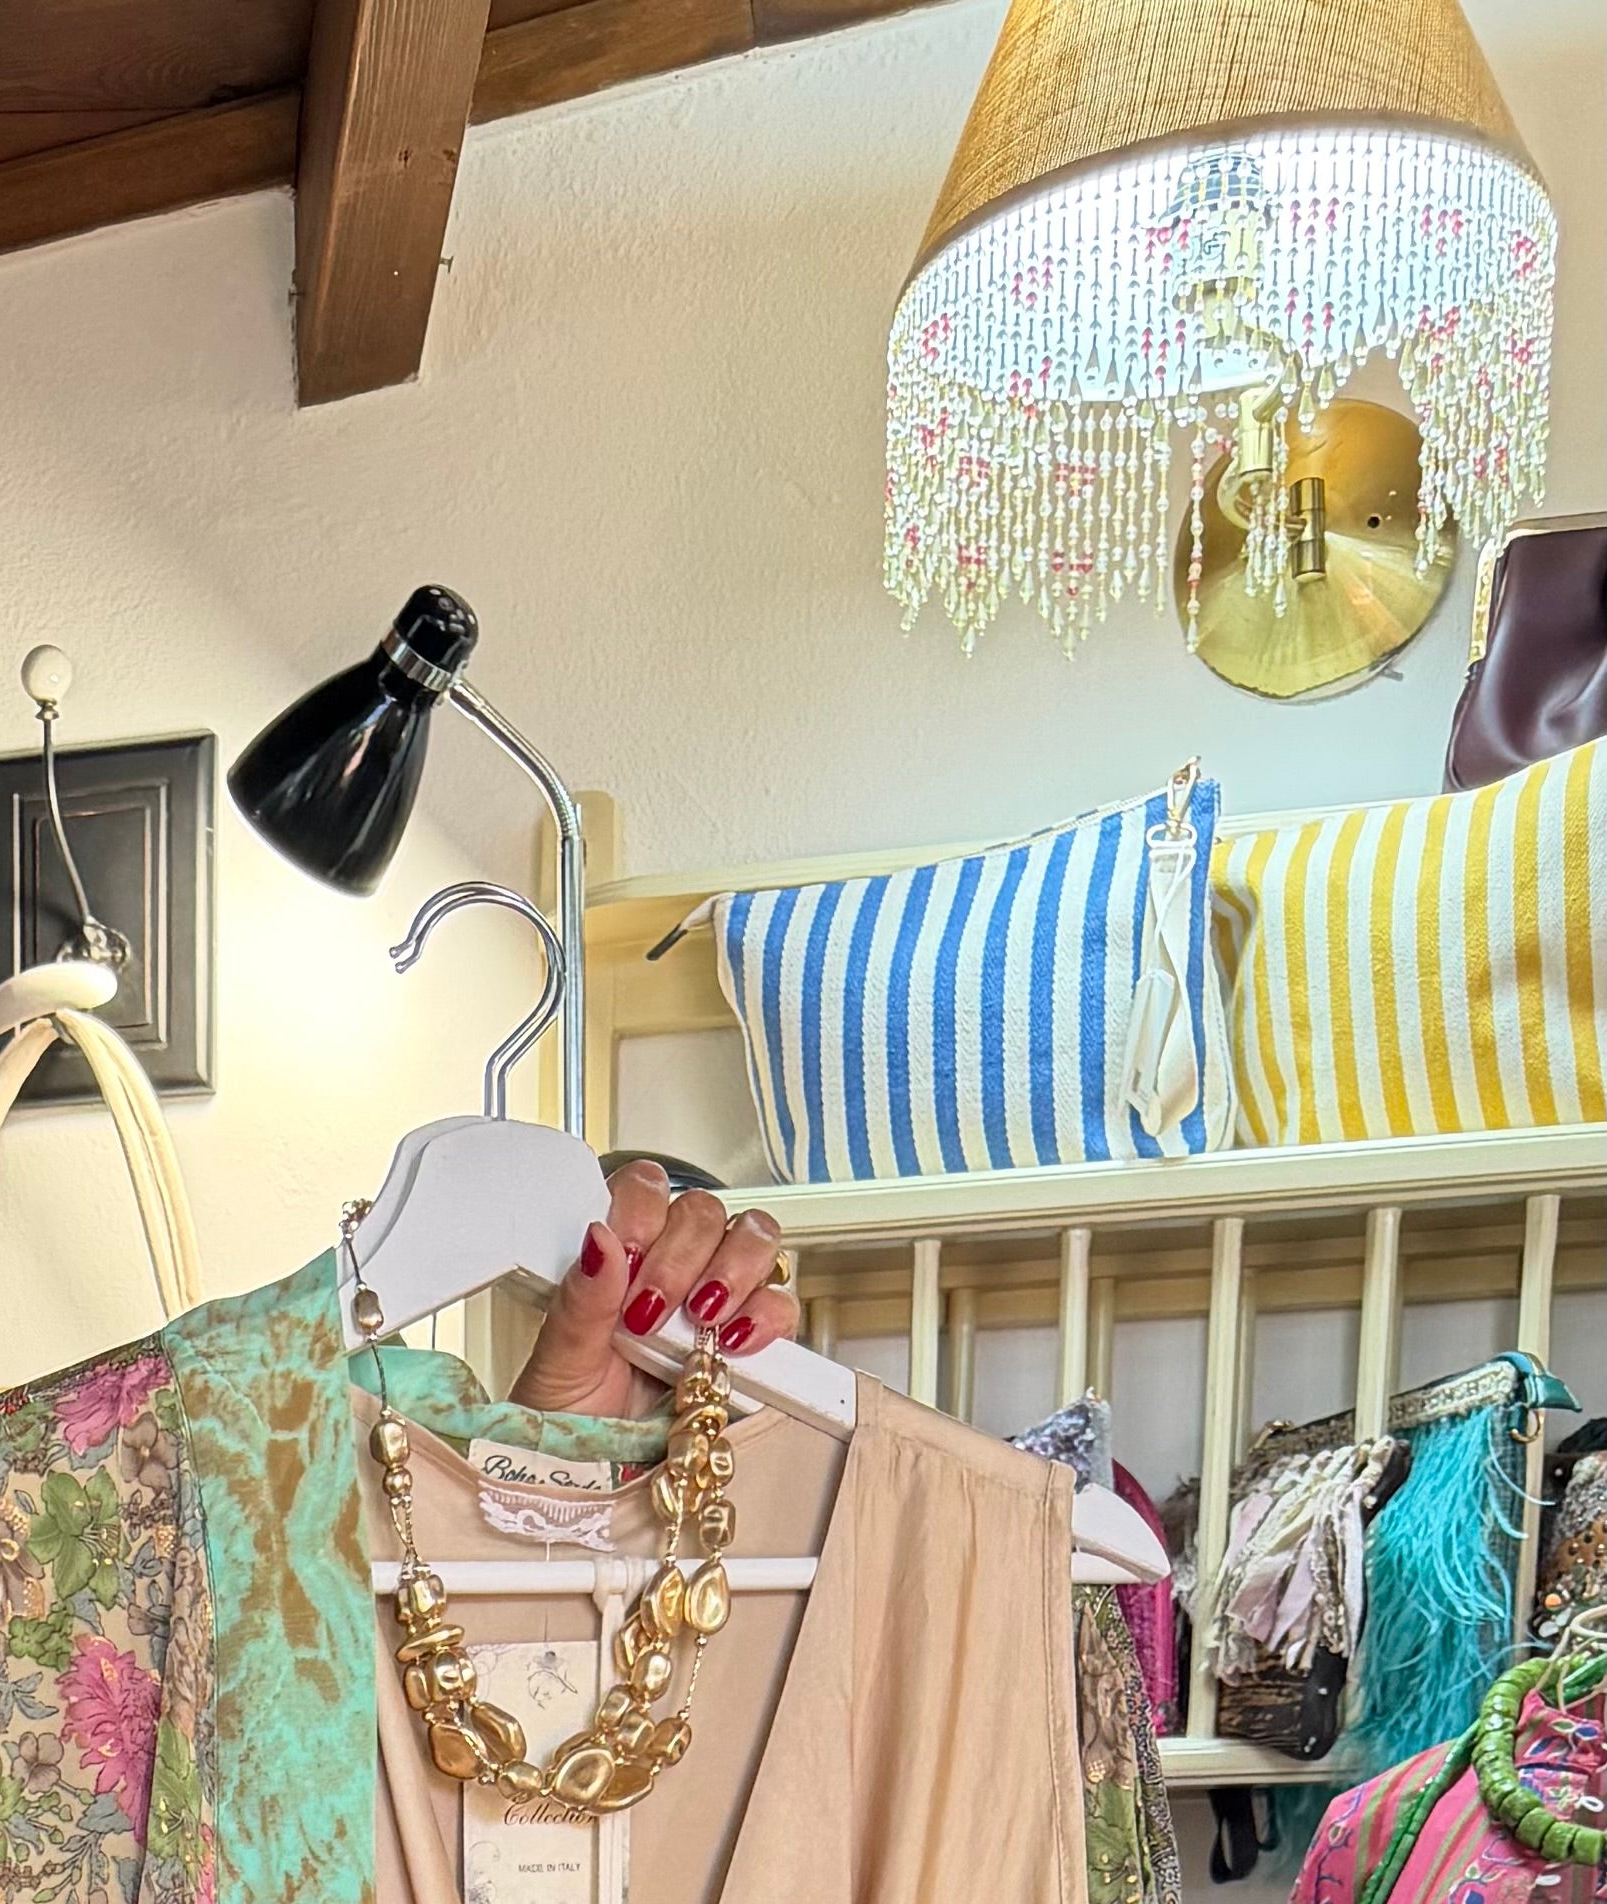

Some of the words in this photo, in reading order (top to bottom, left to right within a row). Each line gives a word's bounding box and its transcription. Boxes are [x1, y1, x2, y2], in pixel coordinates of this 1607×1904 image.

[518, 1863, 544, 1873] MADE
[546, 1863, 556, 1872] IN
[557, 1862, 581, 1872] ITALY
